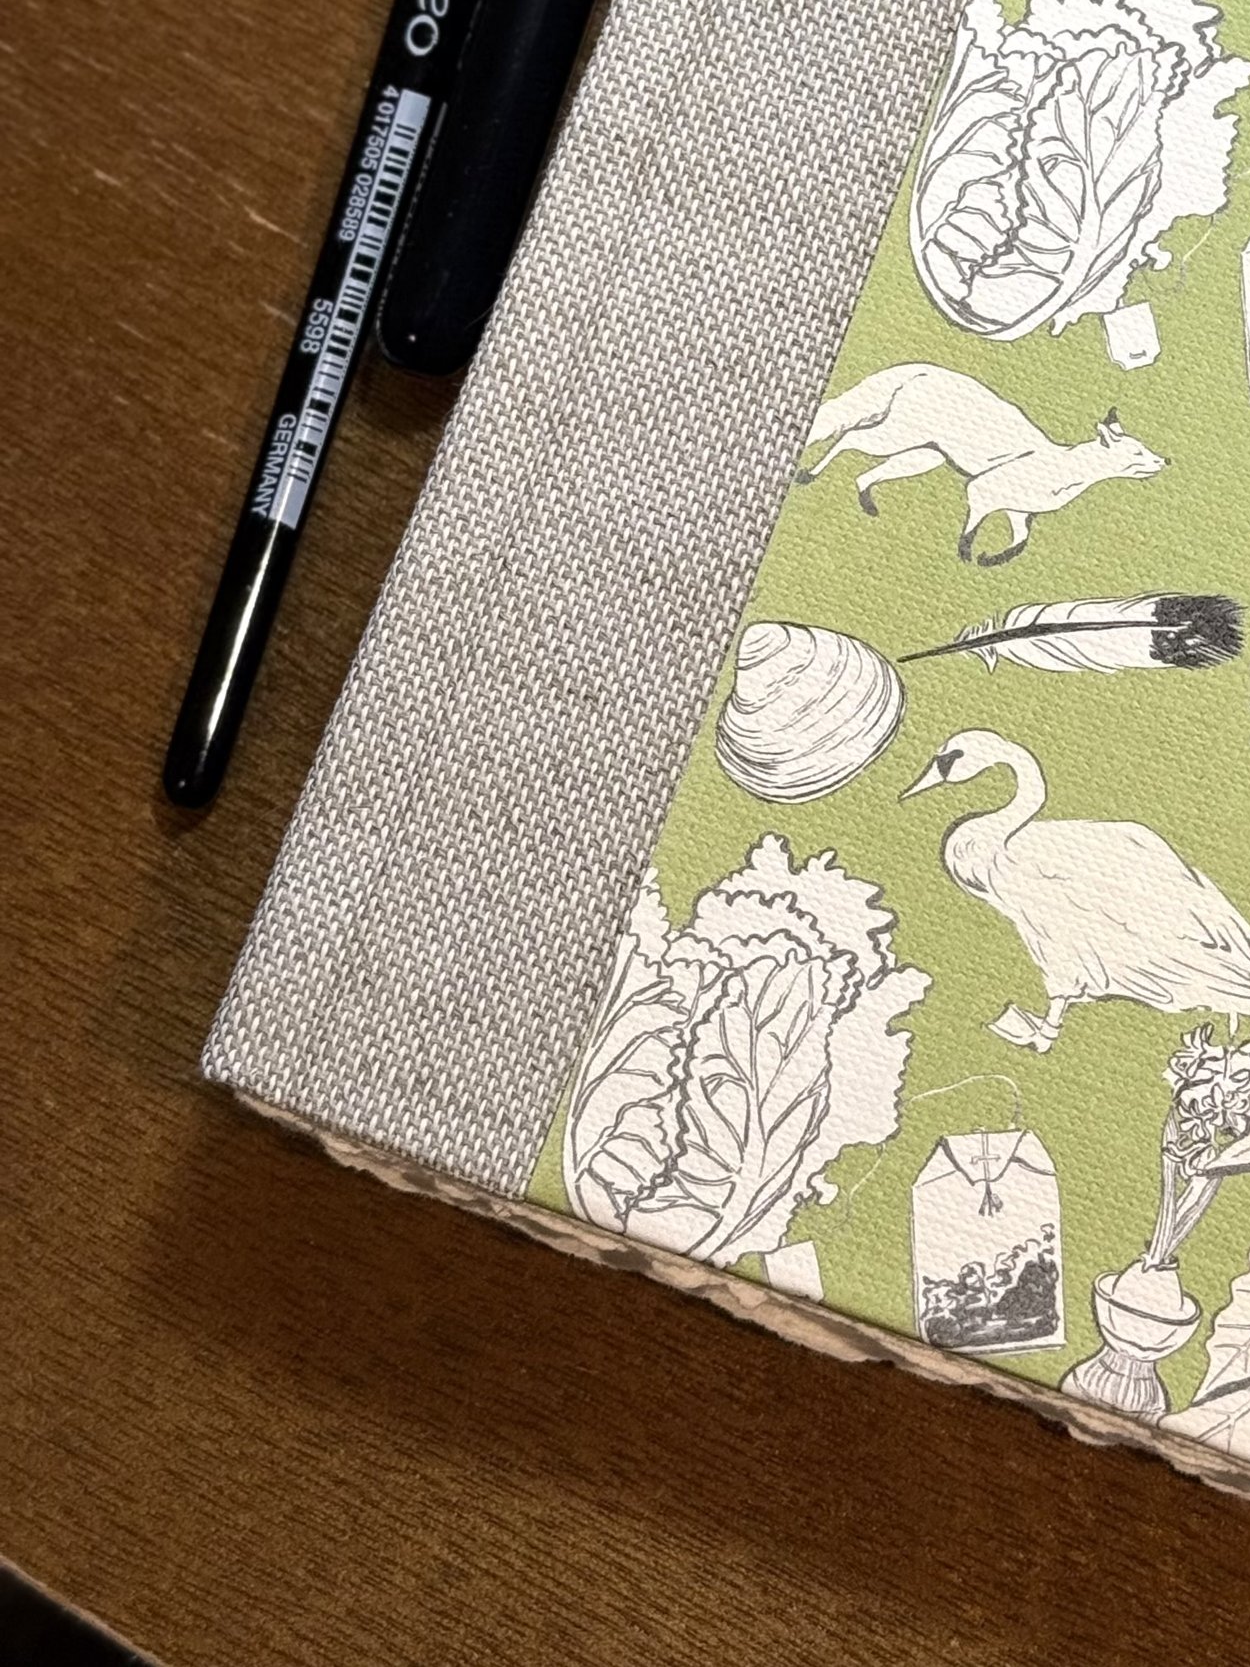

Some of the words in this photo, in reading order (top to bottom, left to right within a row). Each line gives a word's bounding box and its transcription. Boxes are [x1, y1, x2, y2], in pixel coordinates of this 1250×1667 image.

[381, 84, 399, 99] 4
[361, 100, 395, 172] 017505
[339, 172, 373, 242] 028589
[300, 297, 333, 355] 5598
[252, 413, 297, 517] GERMANY
